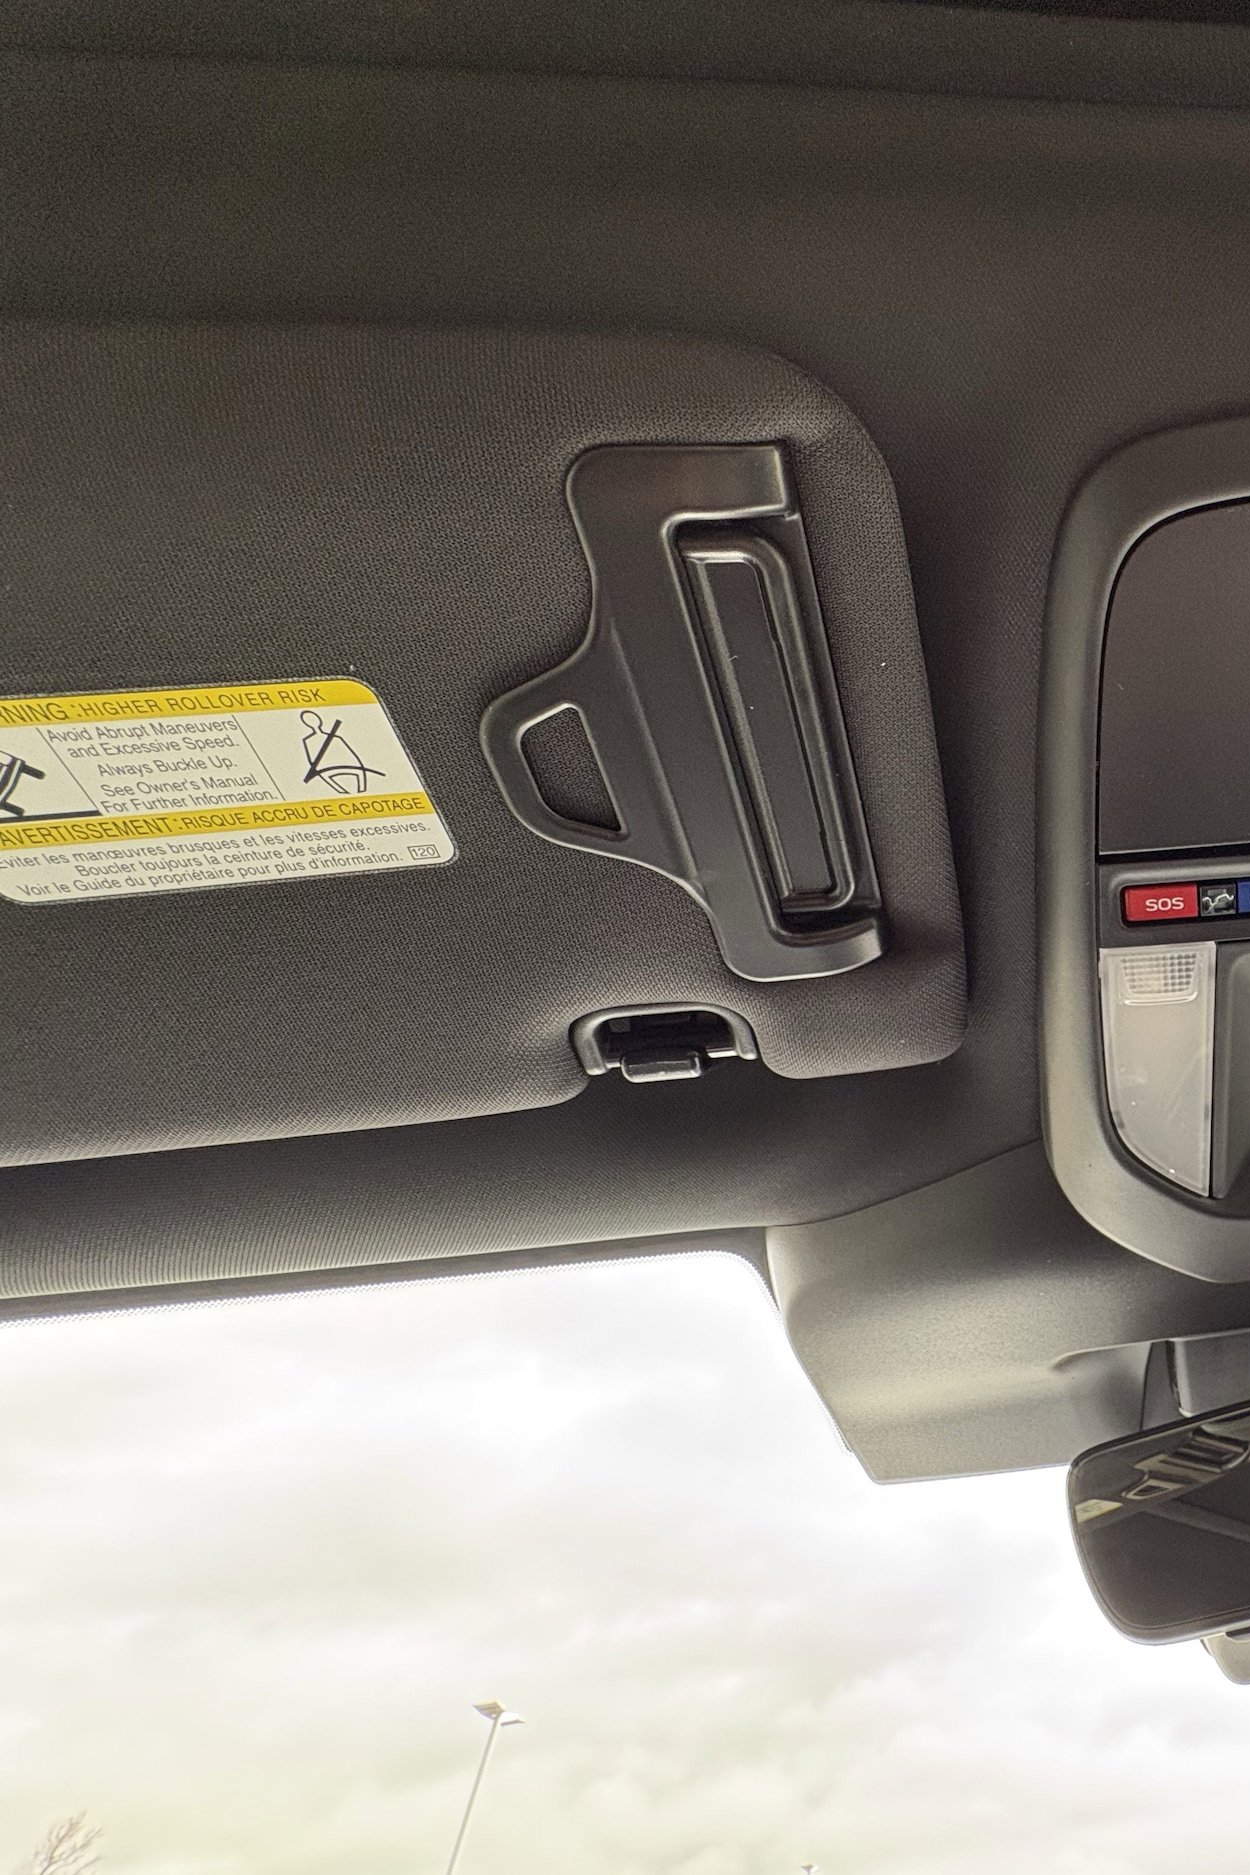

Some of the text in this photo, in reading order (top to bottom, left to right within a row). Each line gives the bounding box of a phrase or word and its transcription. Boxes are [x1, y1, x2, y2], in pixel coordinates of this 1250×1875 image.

[0, 703, 70, 723] NING
[165, 692, 272, 712] ROLLOVER
[278, 688, 327, 704] RISK
[47, 718, 237, 743] Avoid Abrupt Maneuvers
[68, 734, 239, 759] and Excessive Speed.
[97, 755, 238, 777] Always Buckle Up.
[100, 774, 258, 798] See Owner's Manual
[100, 789, 278, 813] For Further Information.
[182, 812, 249, 829] RISQUE
[253, 807, 308, 824] ACCRU
[311, 804, 337, 818] DE
[338, 797, 425, 815] CAPOTAGE
[41, 853, 70, 865] les
[73, 847, 170, 862] manœuvres
[167, 839, 240, 855] brusques
[243, 836, 259, 847] et
[259, 834, 284, 846] les
[285, 828, 347, 843] vitesses
[350, 821, 431, 837] excessives.
[411, 847, 436, 858] 120
[75, 839, 370, 877] Boucler toujours la ceinture de sécurité.
[17, 852, 403, 897] Voir le Guide du propriétaire pour plus d'information.
[1145, 897, 1184, 912] SOS
